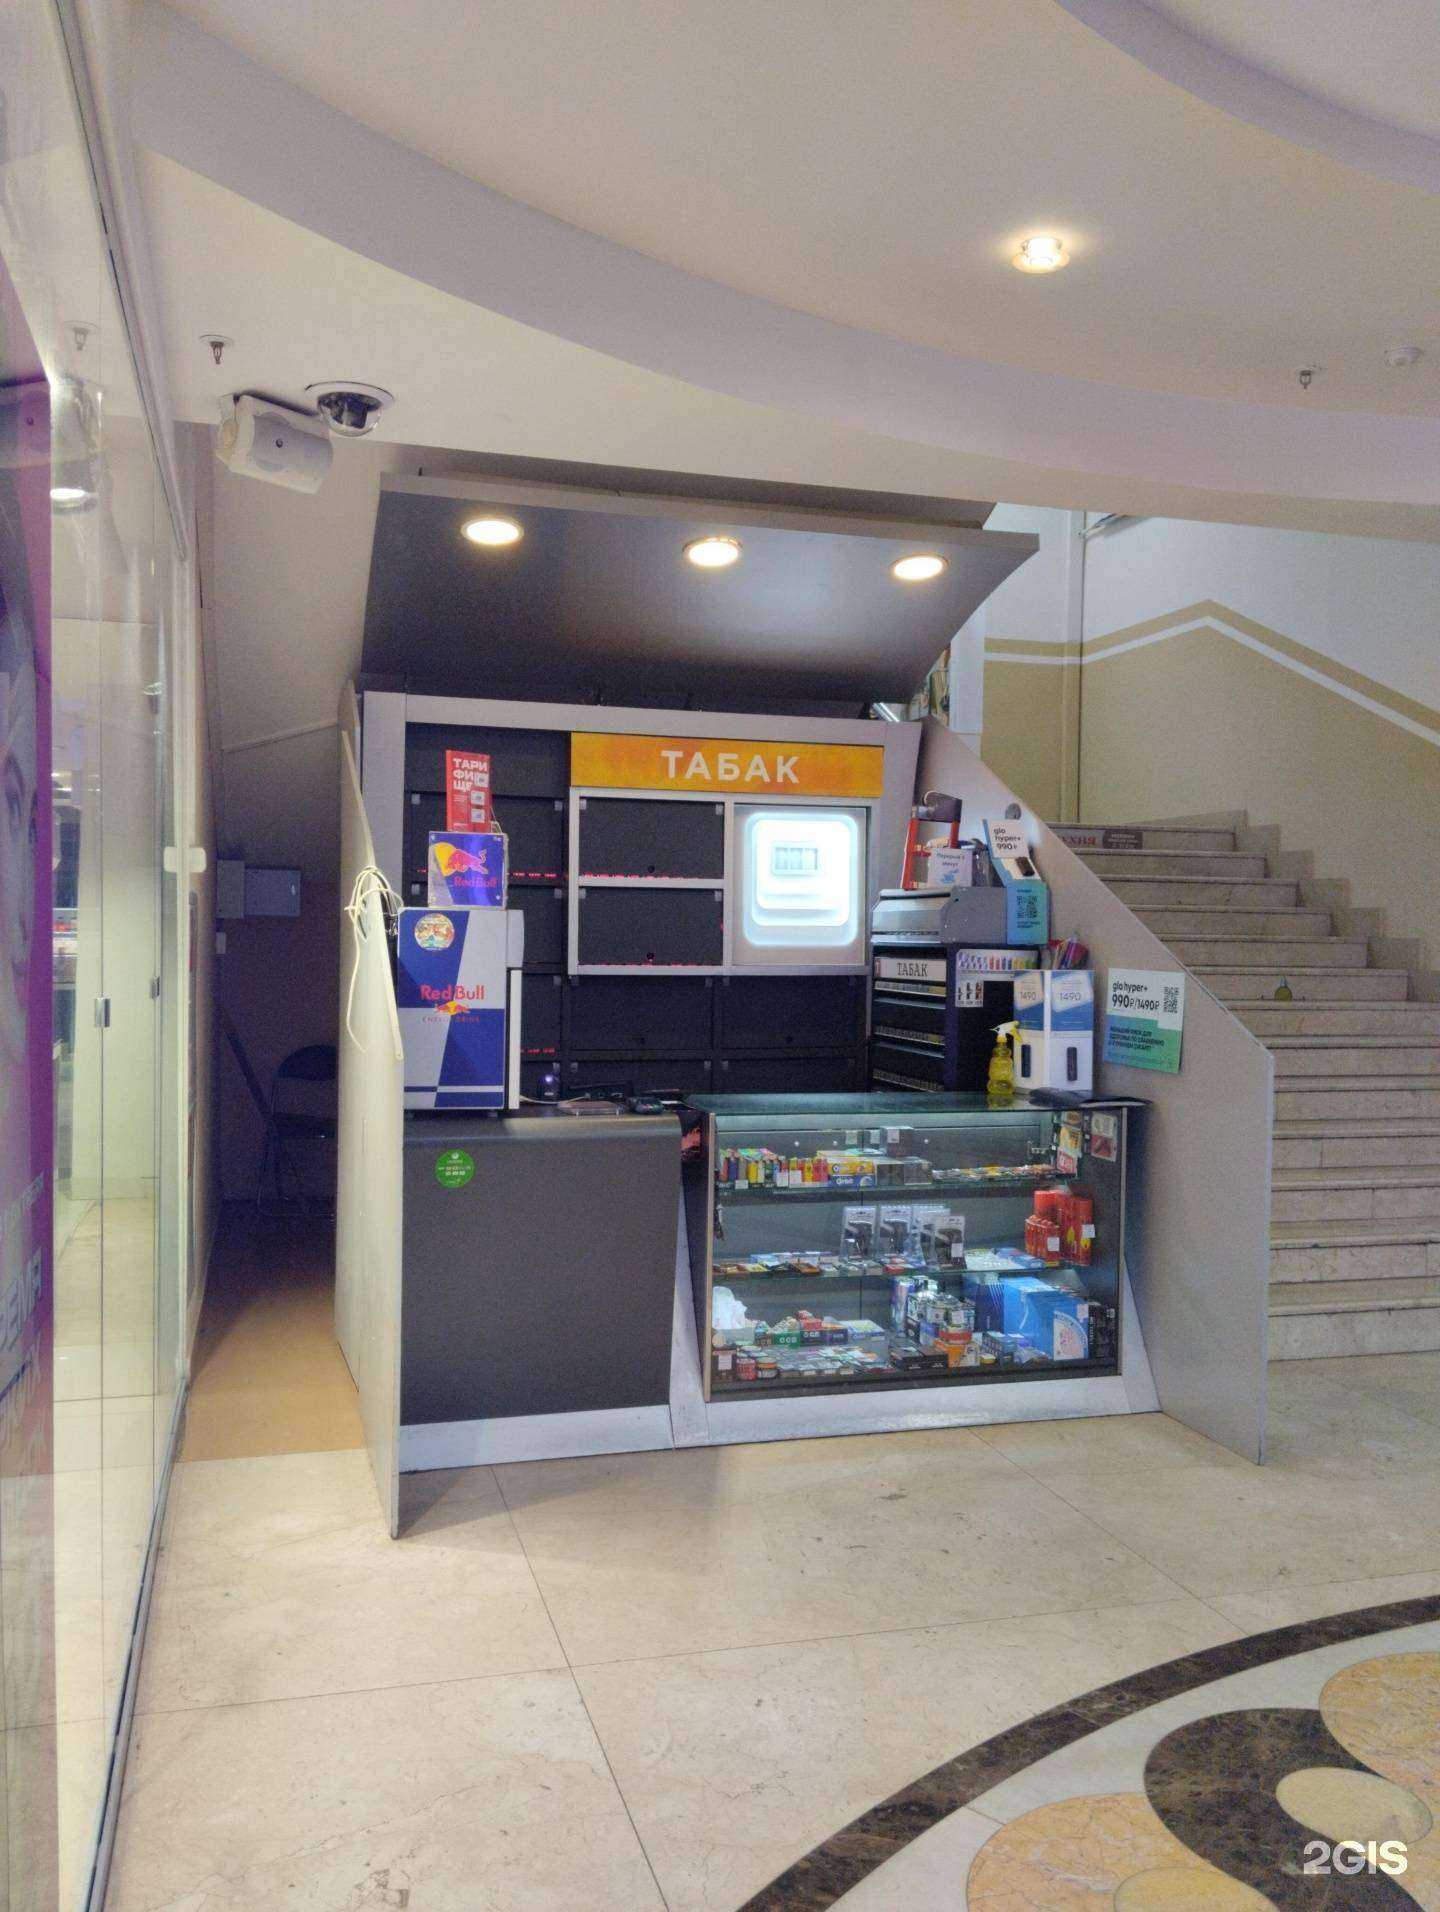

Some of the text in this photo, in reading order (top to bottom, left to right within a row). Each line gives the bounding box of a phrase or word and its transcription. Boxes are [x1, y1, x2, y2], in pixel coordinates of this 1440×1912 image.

[452, 758, 488, 771] ТАРИ
[661, 750, 799, 784] ТАБАК
[897, 962, 928, 977] ТАБАК
[421, 984, 485, 1000] Red Bull
[1112, 980, 1148, 993] glo hyper+
[1059, 992, 1081, 1001] 1490
